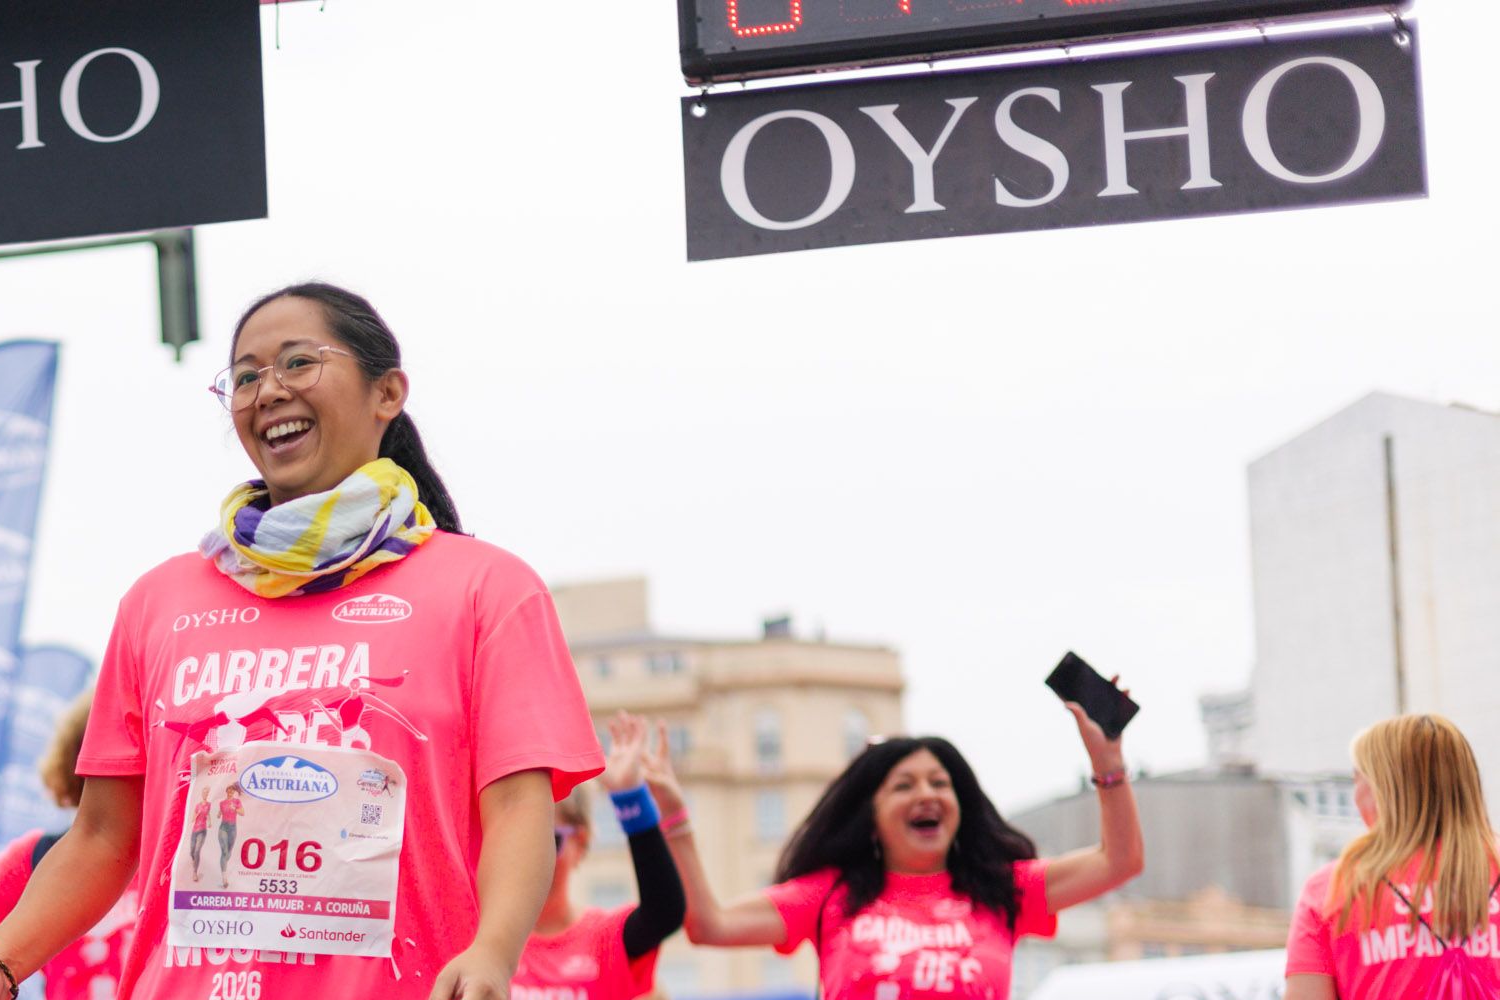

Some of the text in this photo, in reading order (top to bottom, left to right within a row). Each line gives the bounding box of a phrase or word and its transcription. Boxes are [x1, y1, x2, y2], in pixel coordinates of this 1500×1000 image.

[720, 55, 1386, 232] OYSHO
[172, 606, 260, 632] OYSHO
[338, 605, 405, 616] ASTURIANA
[172, 642, 371, 706] CARRERA
[246, 771, 329, 793] ASTURIANA
[240, 837, 323, 873] 016
[259, 878, 298, 894] 5533
[190, 895, 371, 915] CARRERA DE LA MUJER A CORUÑA
[192, 919, 254, 936] OYSHO
[299, 927, 366, 943] Santander
